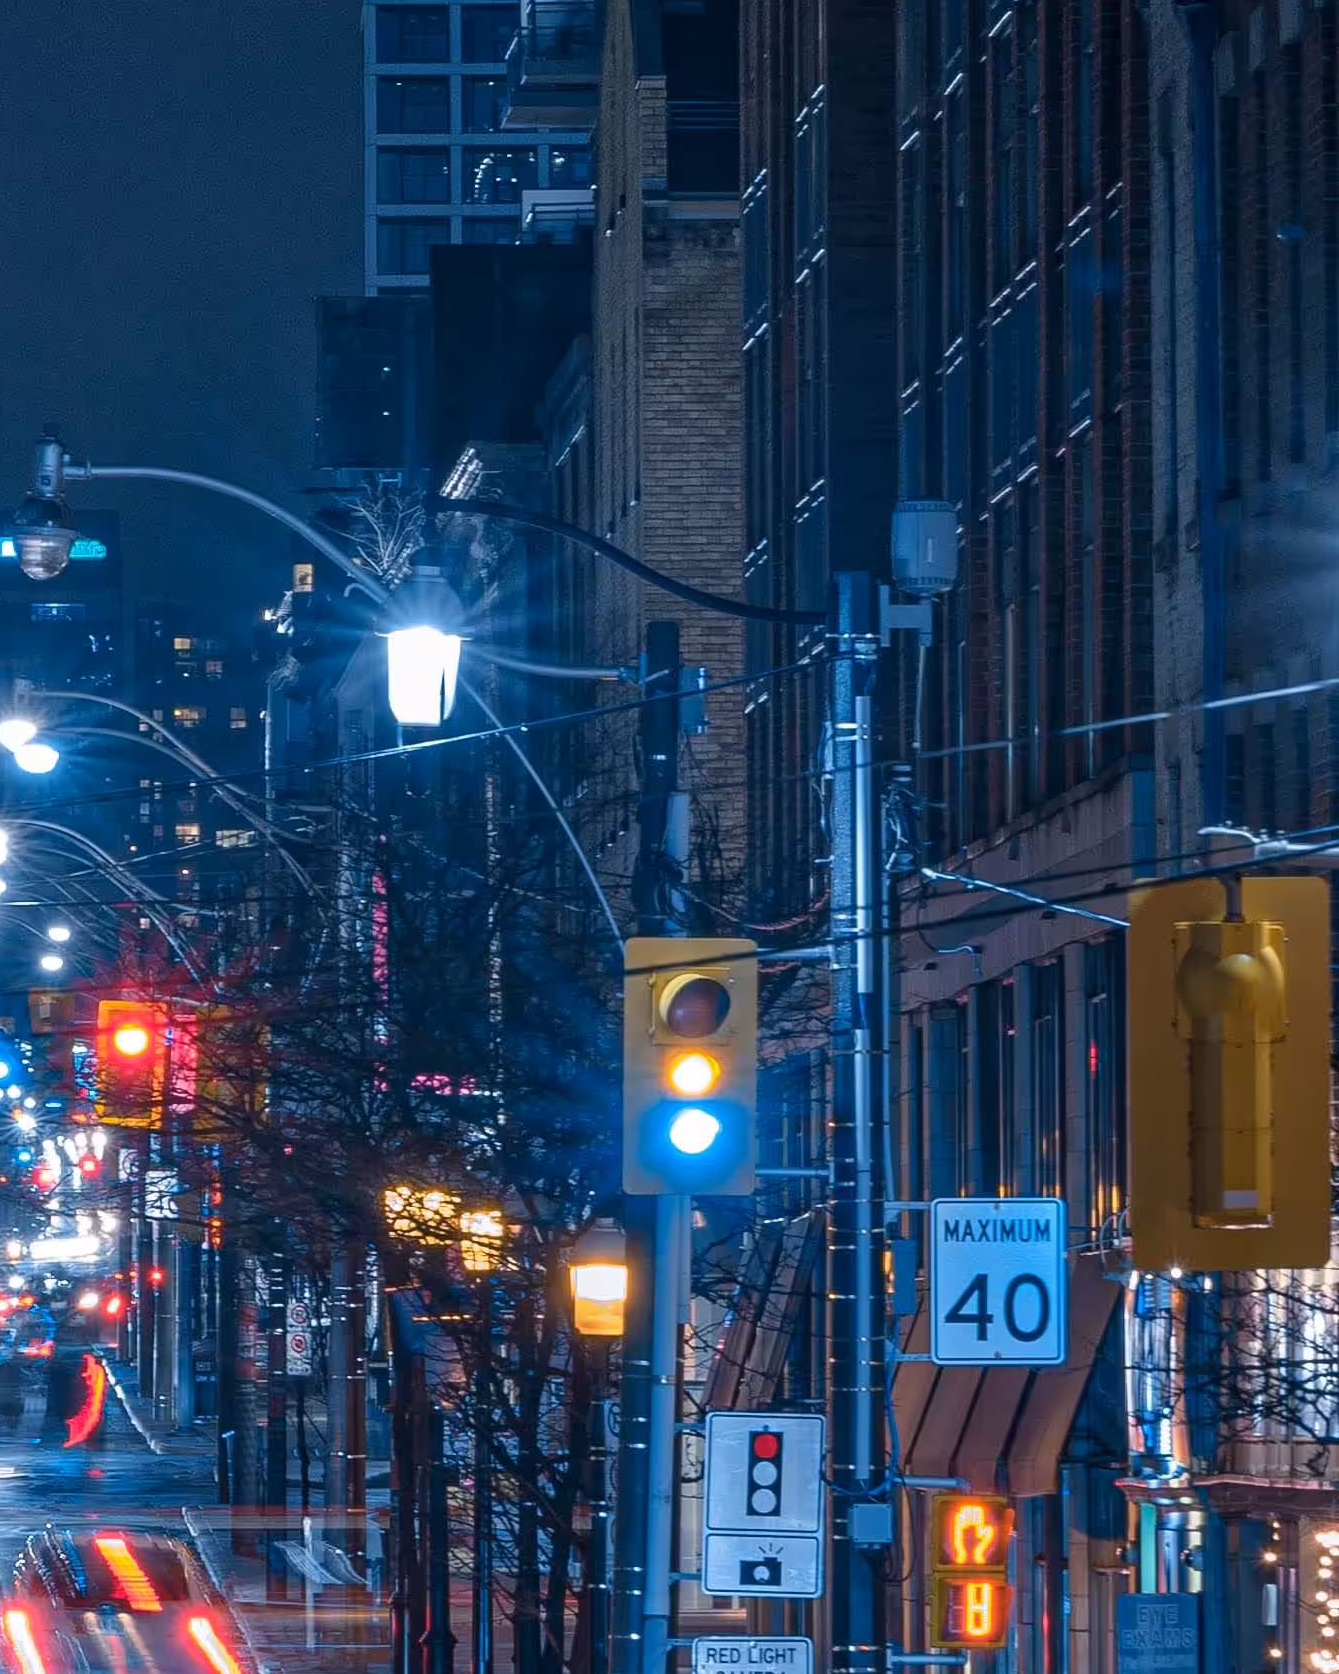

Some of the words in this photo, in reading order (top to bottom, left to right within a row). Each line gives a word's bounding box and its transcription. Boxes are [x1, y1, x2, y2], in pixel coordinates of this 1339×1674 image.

[944, 1219, 1051, 1242] MAXIMUM
[944, 1273, 1050, 1343] 40
[1137, 1604, 1179, 1624] EYE
[1122, 1628, 1196, 1648] EXAMS
[706, 1647, 741, 1664] RED
[747, 1647, 796, 1664] LIGHT
